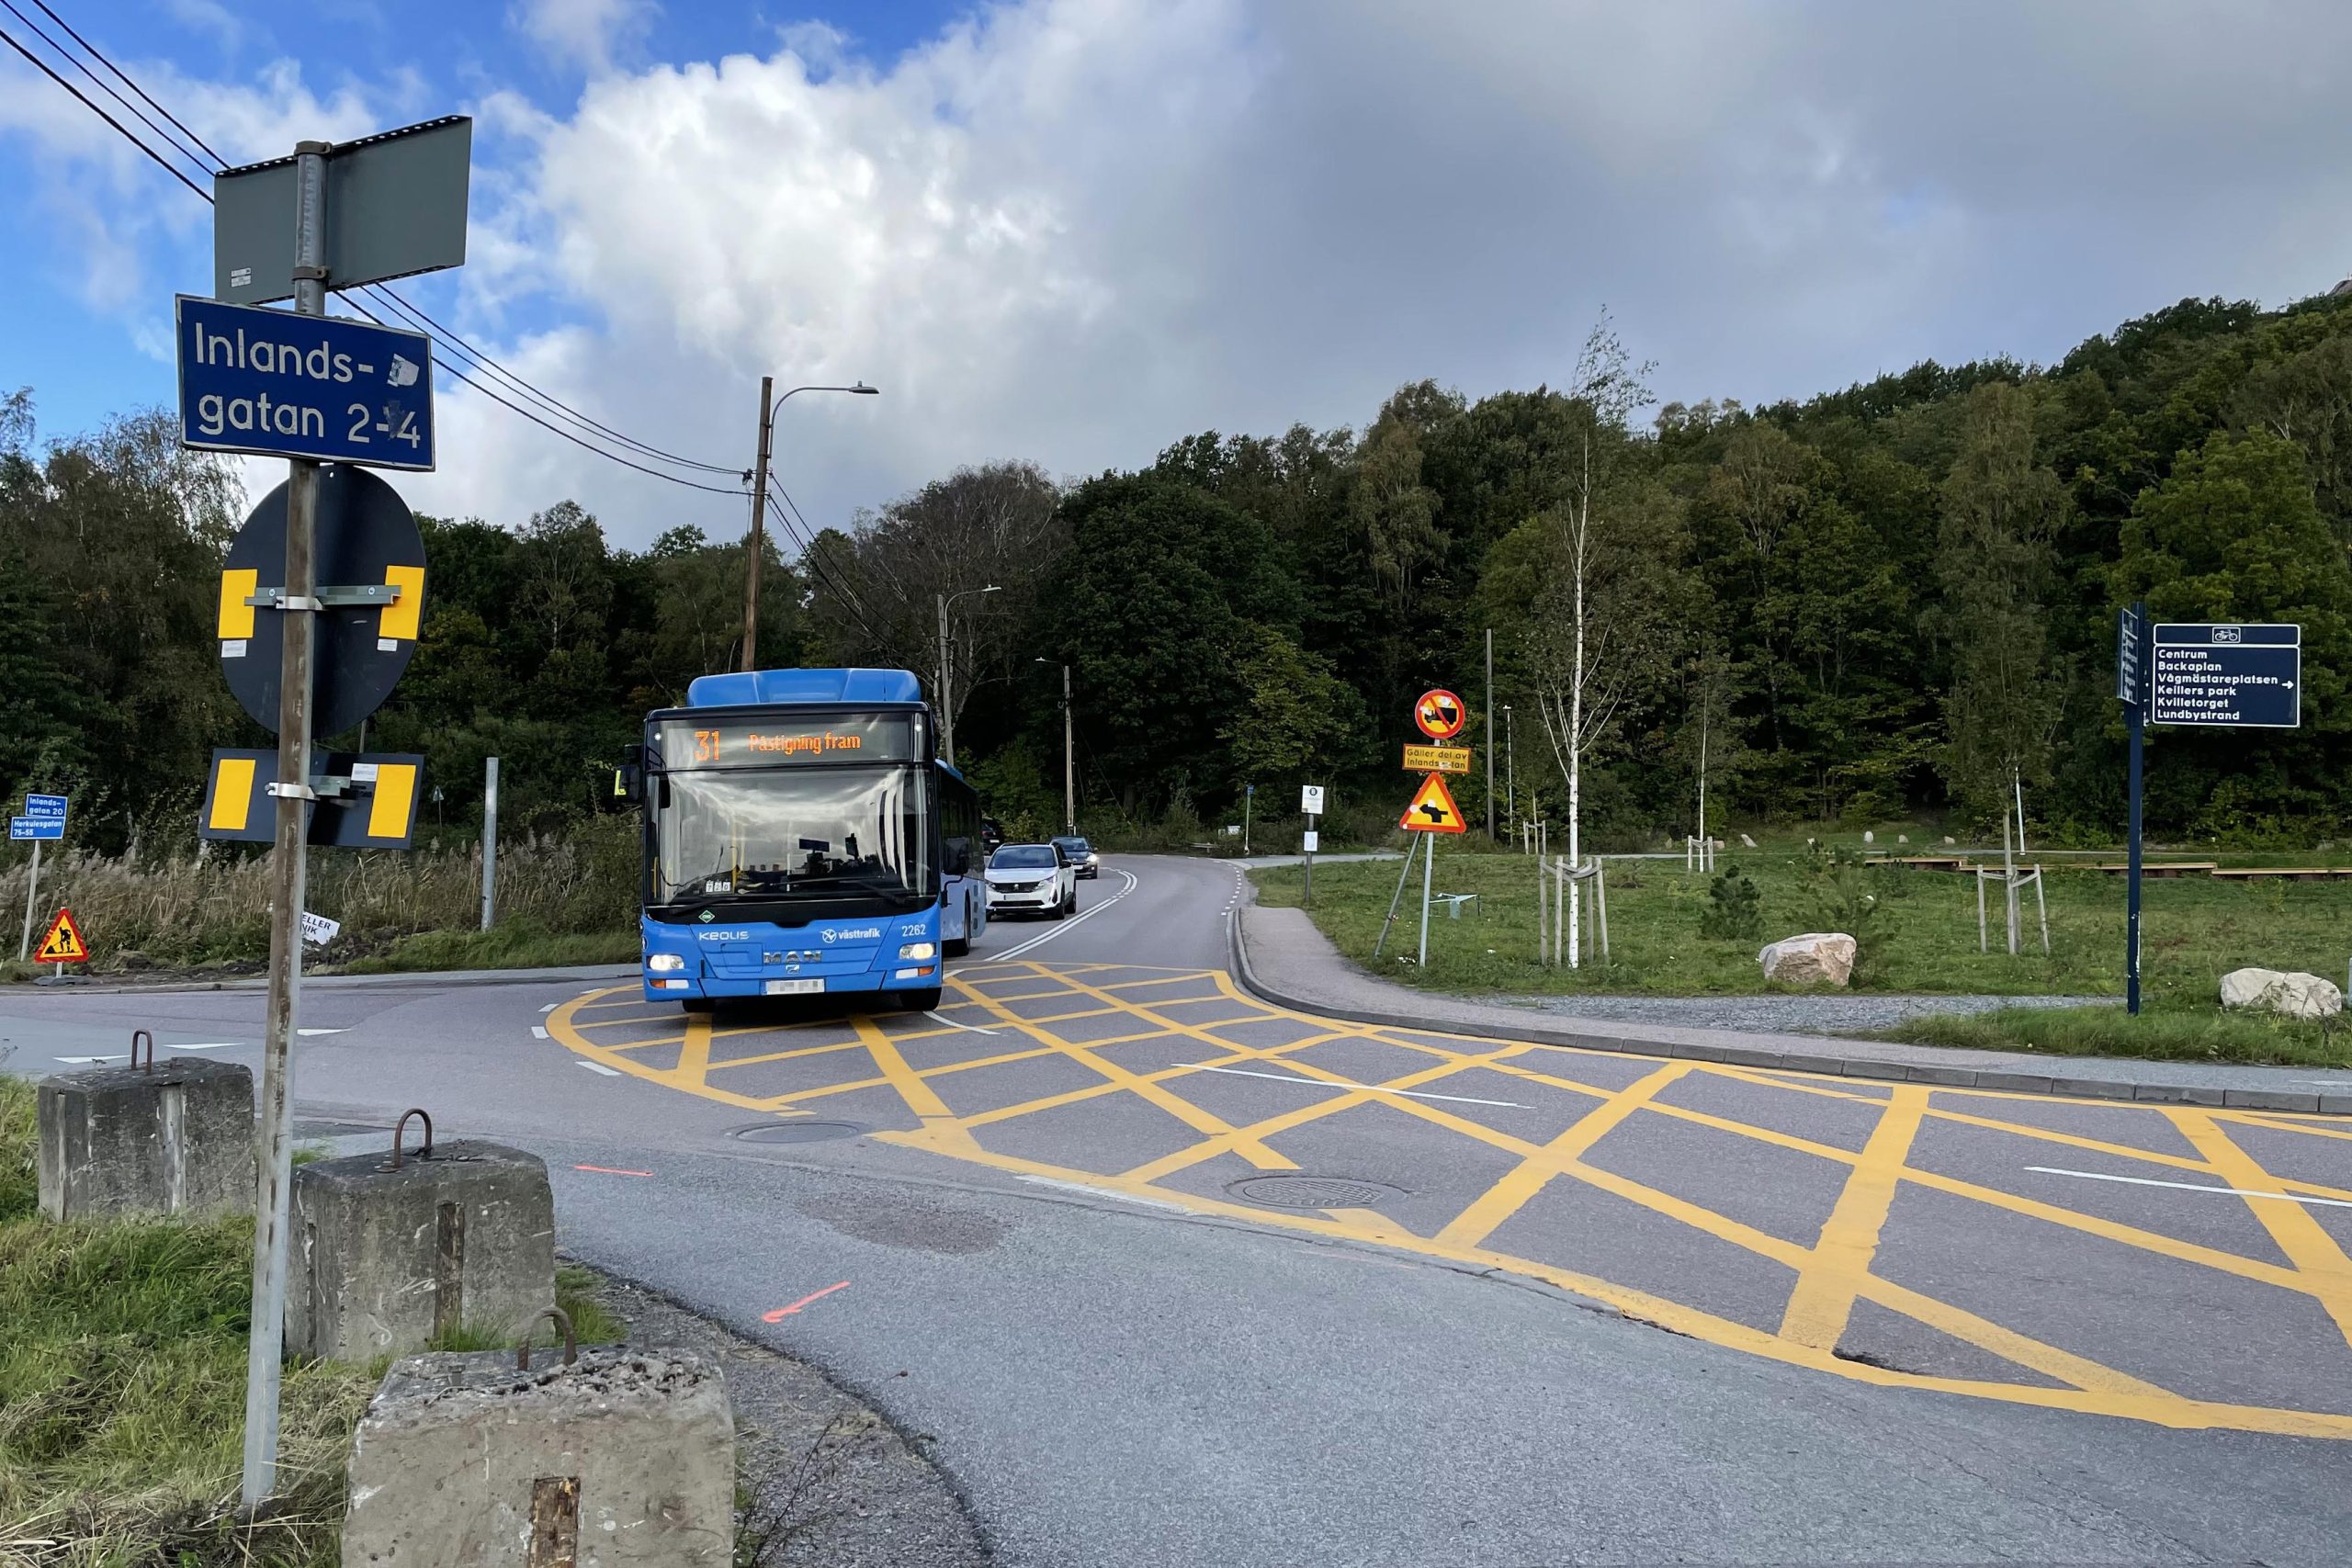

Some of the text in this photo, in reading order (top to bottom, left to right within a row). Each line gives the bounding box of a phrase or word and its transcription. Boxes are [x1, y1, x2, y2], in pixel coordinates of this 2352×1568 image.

[195, 321, 374, 383] Inlands-
[198, 392, 421, 449] gatan 2-4
[2158, 649, 2208, 660] Centrum
[2157, 661, 2222, 672] Backaplan
[2157, 673, 2278, 685] Vågmästareplatsen
[2157, 685, 2237, 697] Keillers park
[2157, 697, 2229, 709] Kvilletorget
[2157, 709, 2240, 721] Lundbystrand
[694, 730, 720, 761] 31
[749, 731, 861, 755] Påstigning fram
[1407, 749, 1434, 758] Gäller
[1438, 750, 1452, 759] del
[1407, 758, 1465, 769] Inlandstan
[29, 796, 62, 807] Inlands-
[14, 819, 62, 829] Herkulesgatan
[838, 928, 881, 940] västtrafik
[901, 924, 927, 937] 2262
[763, 951, 822, 964] MAN
